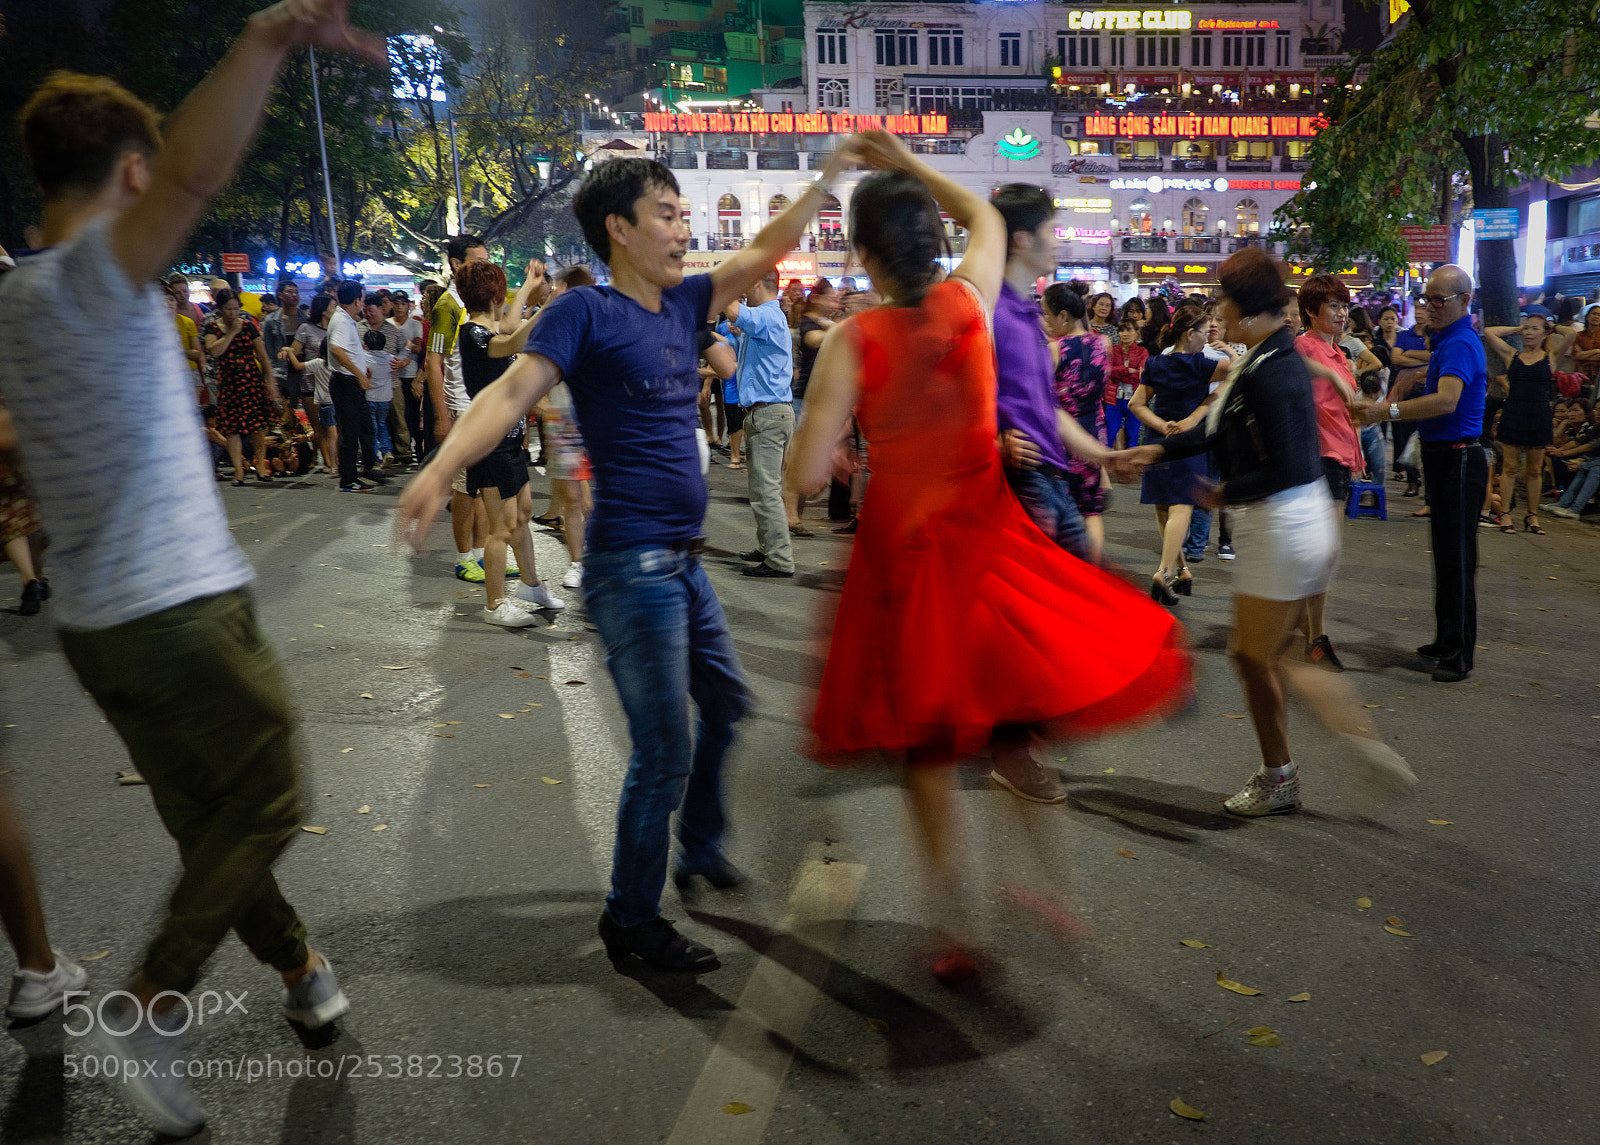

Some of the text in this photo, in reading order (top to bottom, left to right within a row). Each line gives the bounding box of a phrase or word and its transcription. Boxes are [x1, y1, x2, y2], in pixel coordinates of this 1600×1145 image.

[1068, 10, 1192, 30] COFFEE CLUB
[1119, 111, 1150, 139] CỘNG
[1152, 110, 1177, 136] SẢN
[1177, 111, 1203, 139] VIỆT
[1203, 116, 1230, 136] NAM
[1230, 116, 1269, 138] QUANG
[1270, 116, 1298, 136] VINH
[1228, 179, 1301, 190] BURGER KING
